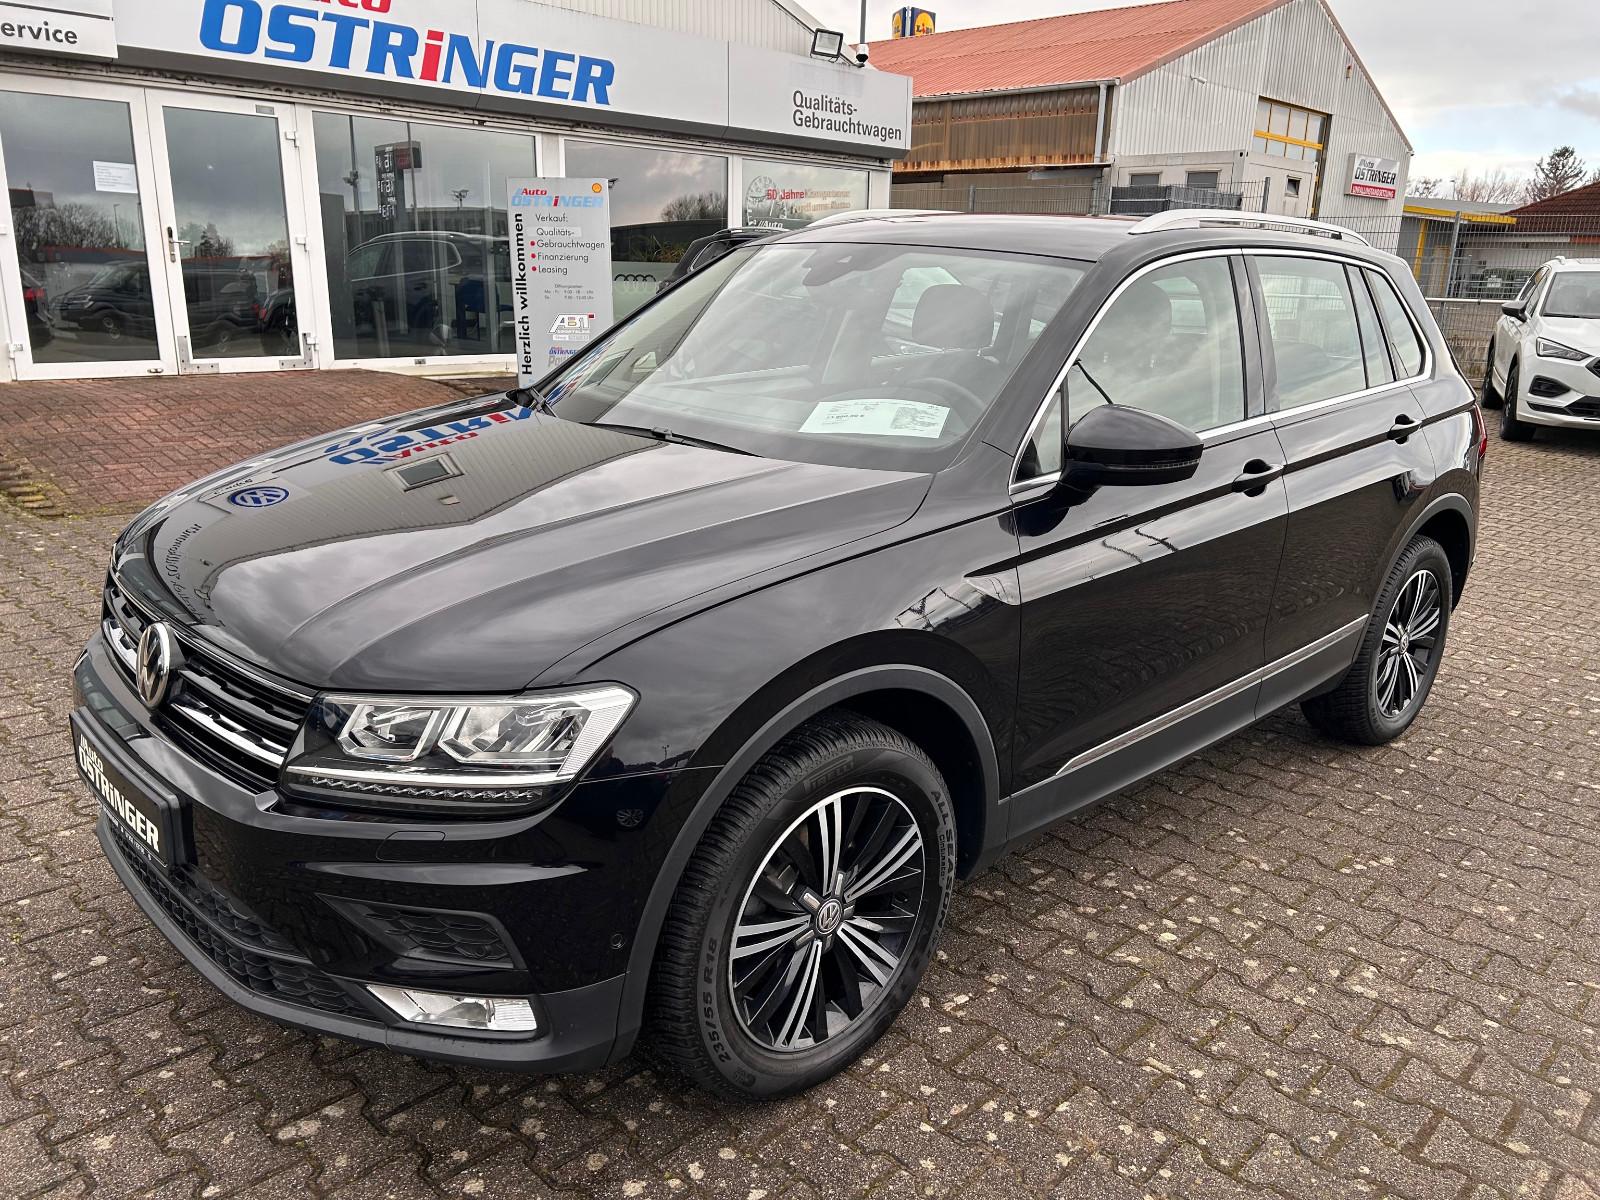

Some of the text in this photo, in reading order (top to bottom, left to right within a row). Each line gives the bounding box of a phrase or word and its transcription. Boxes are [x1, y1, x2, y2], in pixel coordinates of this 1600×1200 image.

[1, 20, 78, 44] ervice
[793, 90, 858, 116] Qualitäts-
[792, 109, 902, 142] Gebrauchtwagen
[518, 188, 547, 196] Auto
[780, 189, 805, 200] Jahre
[536, 213, 568, 222] Verkauf:
[536, 227, 575, 237] Qualitäts-
[536, 240, 605, 251] Gebrauchtwagen
[537, 252, 589, 263] Finanzierung
[514, 212, 530, 310] willkommen
[538, 265, 568, 275] Leasing
[517, 315, 533, 375] Herzlich
[81, 735, 104, 773] Auto
[930, 790, 951, 826] ALL
[702, 937, 732, 1064] 235/55 R18
